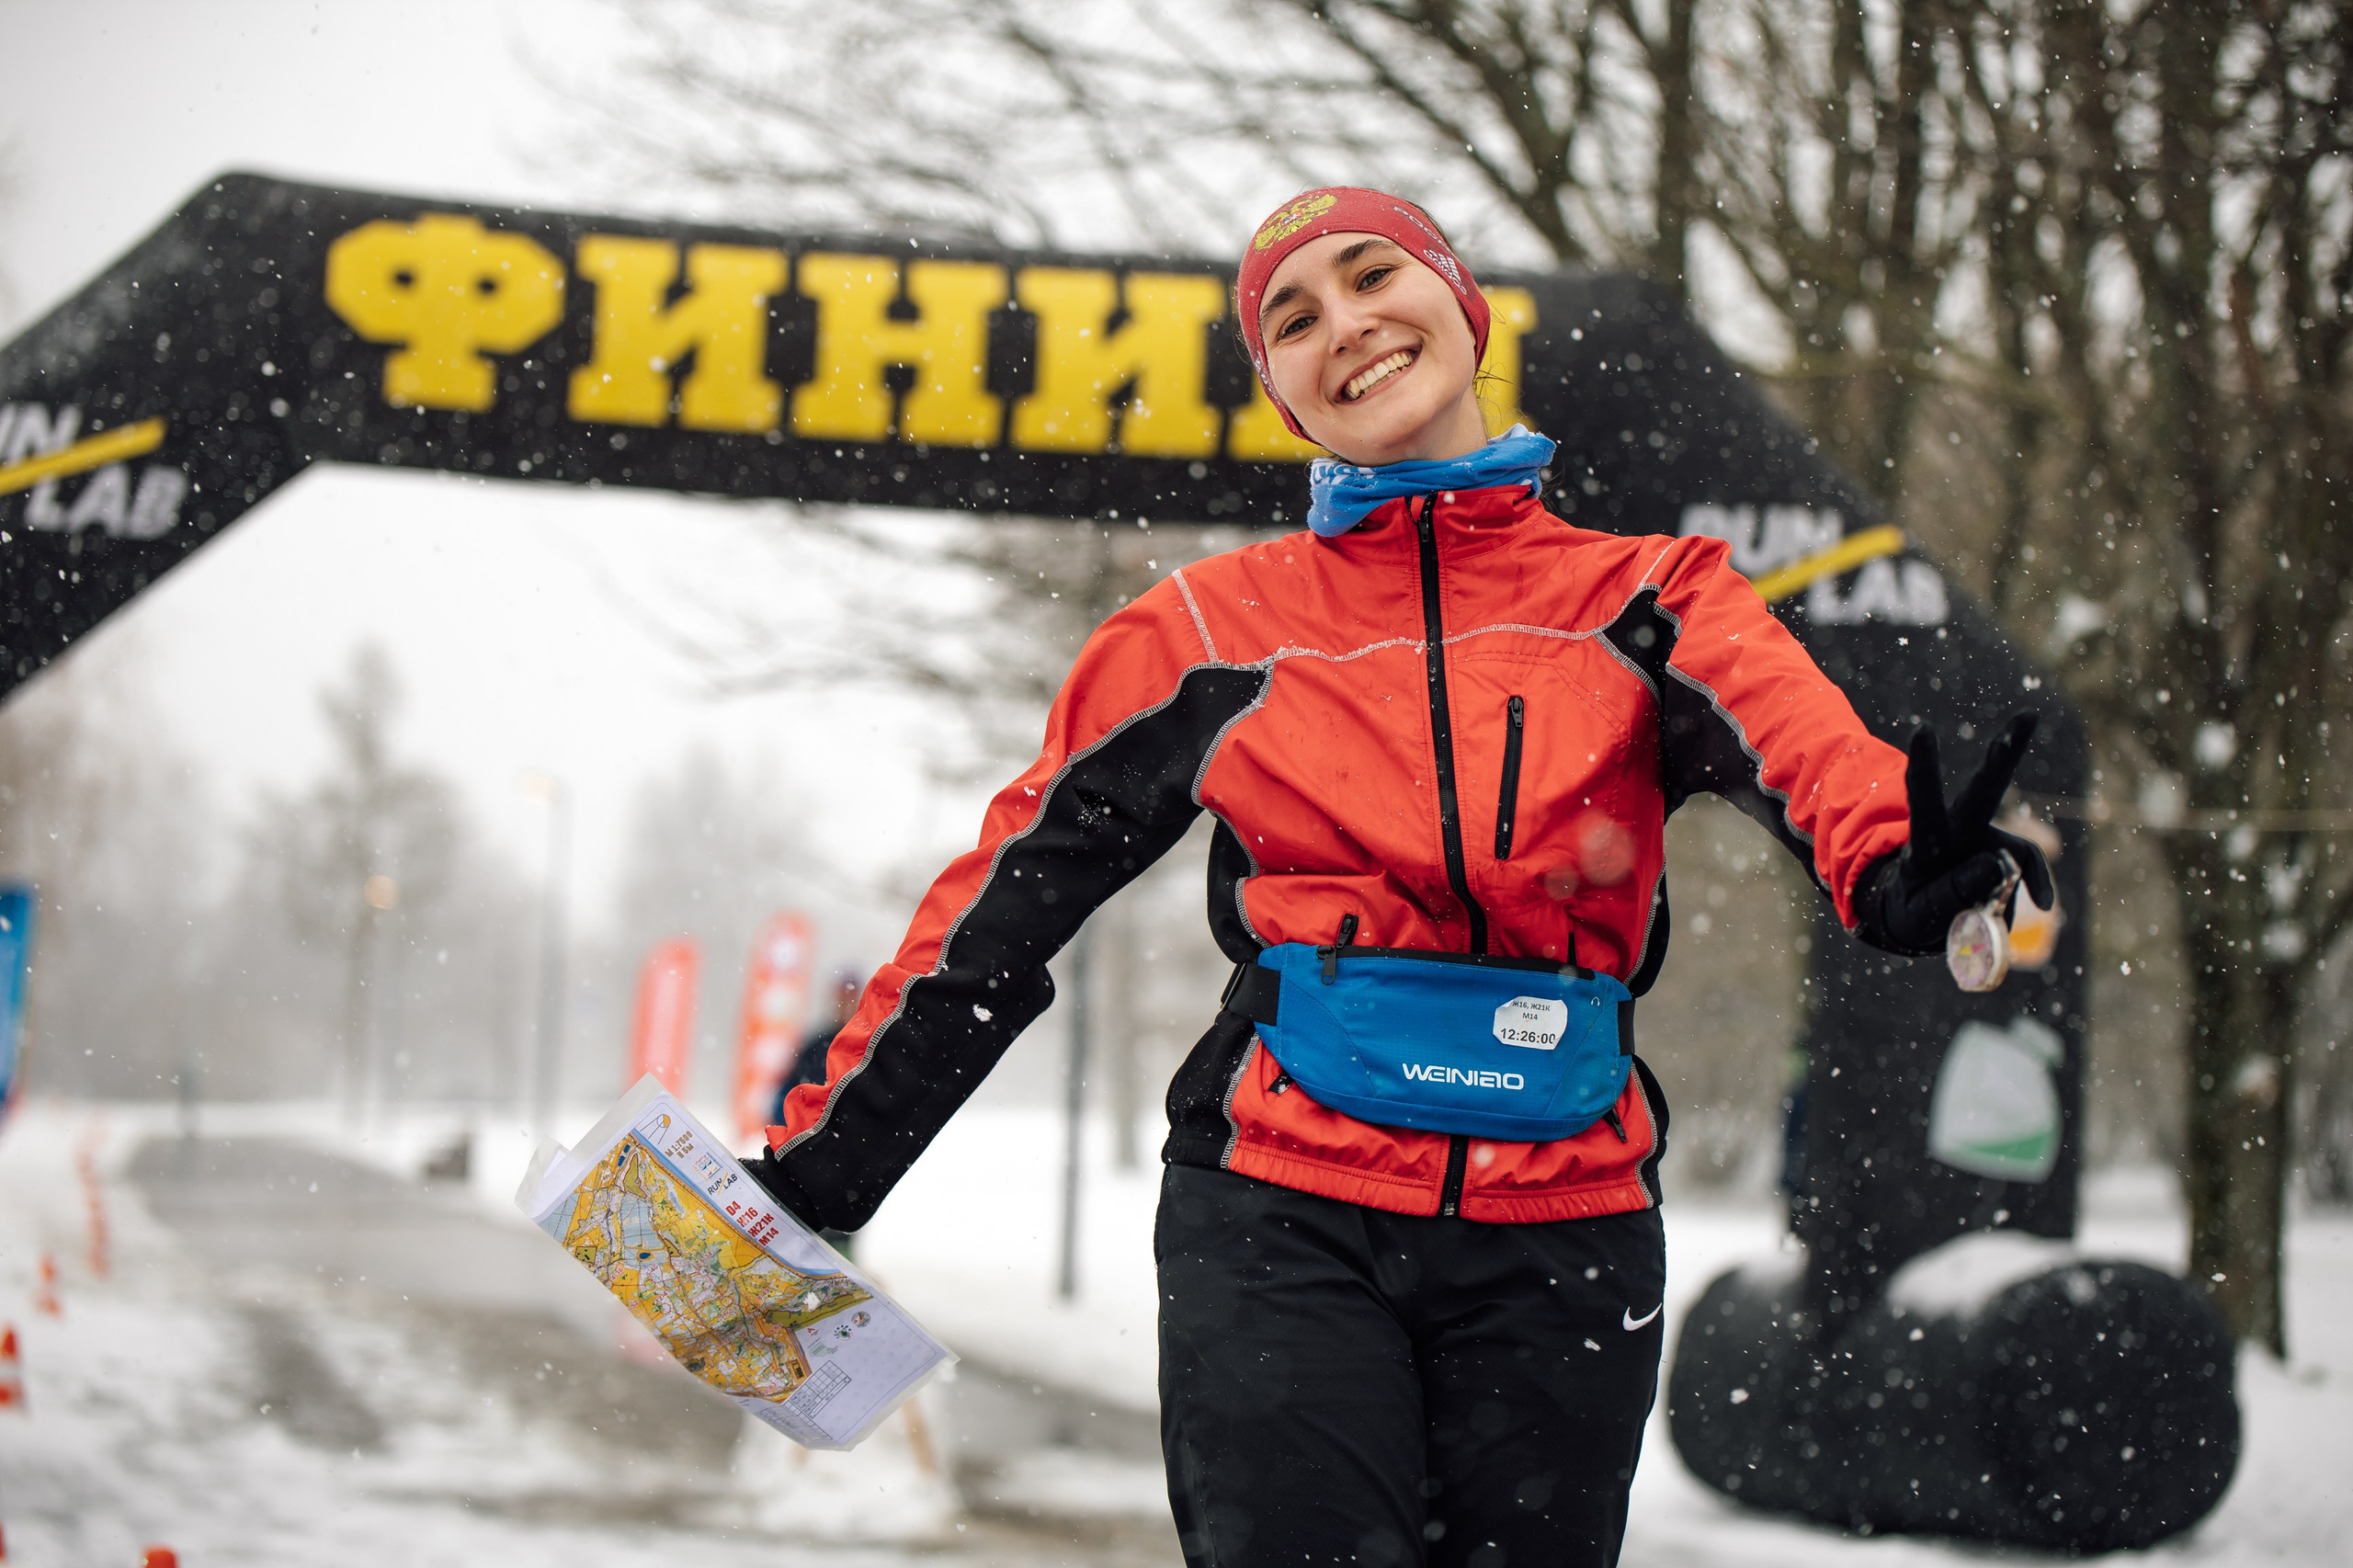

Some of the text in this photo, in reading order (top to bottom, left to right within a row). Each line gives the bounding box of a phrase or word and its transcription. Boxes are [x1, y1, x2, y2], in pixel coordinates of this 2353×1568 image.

[1423, 249, 1468, 295] adidas
[26, 462, 189, 540] LAB
[1512, 1001, 1551, 1012] Ж16, Ж21К
[1501, 1028, 1556, 1044] 12:26:00
[1402, 1062, 1525, 1090] WEINIAO
[671, 1131, 693, 1152] 1:7500
[707, 1177, 722, 1195] RUN
[723, 1173, 738, 1189] LAB
[725, 1200, 742, 1216] D4
[736, 1207, 758, 1228] Ж16
[747, 1212, 775, 1237] Ж21К
[758, 1227, 779, 1246] М14
